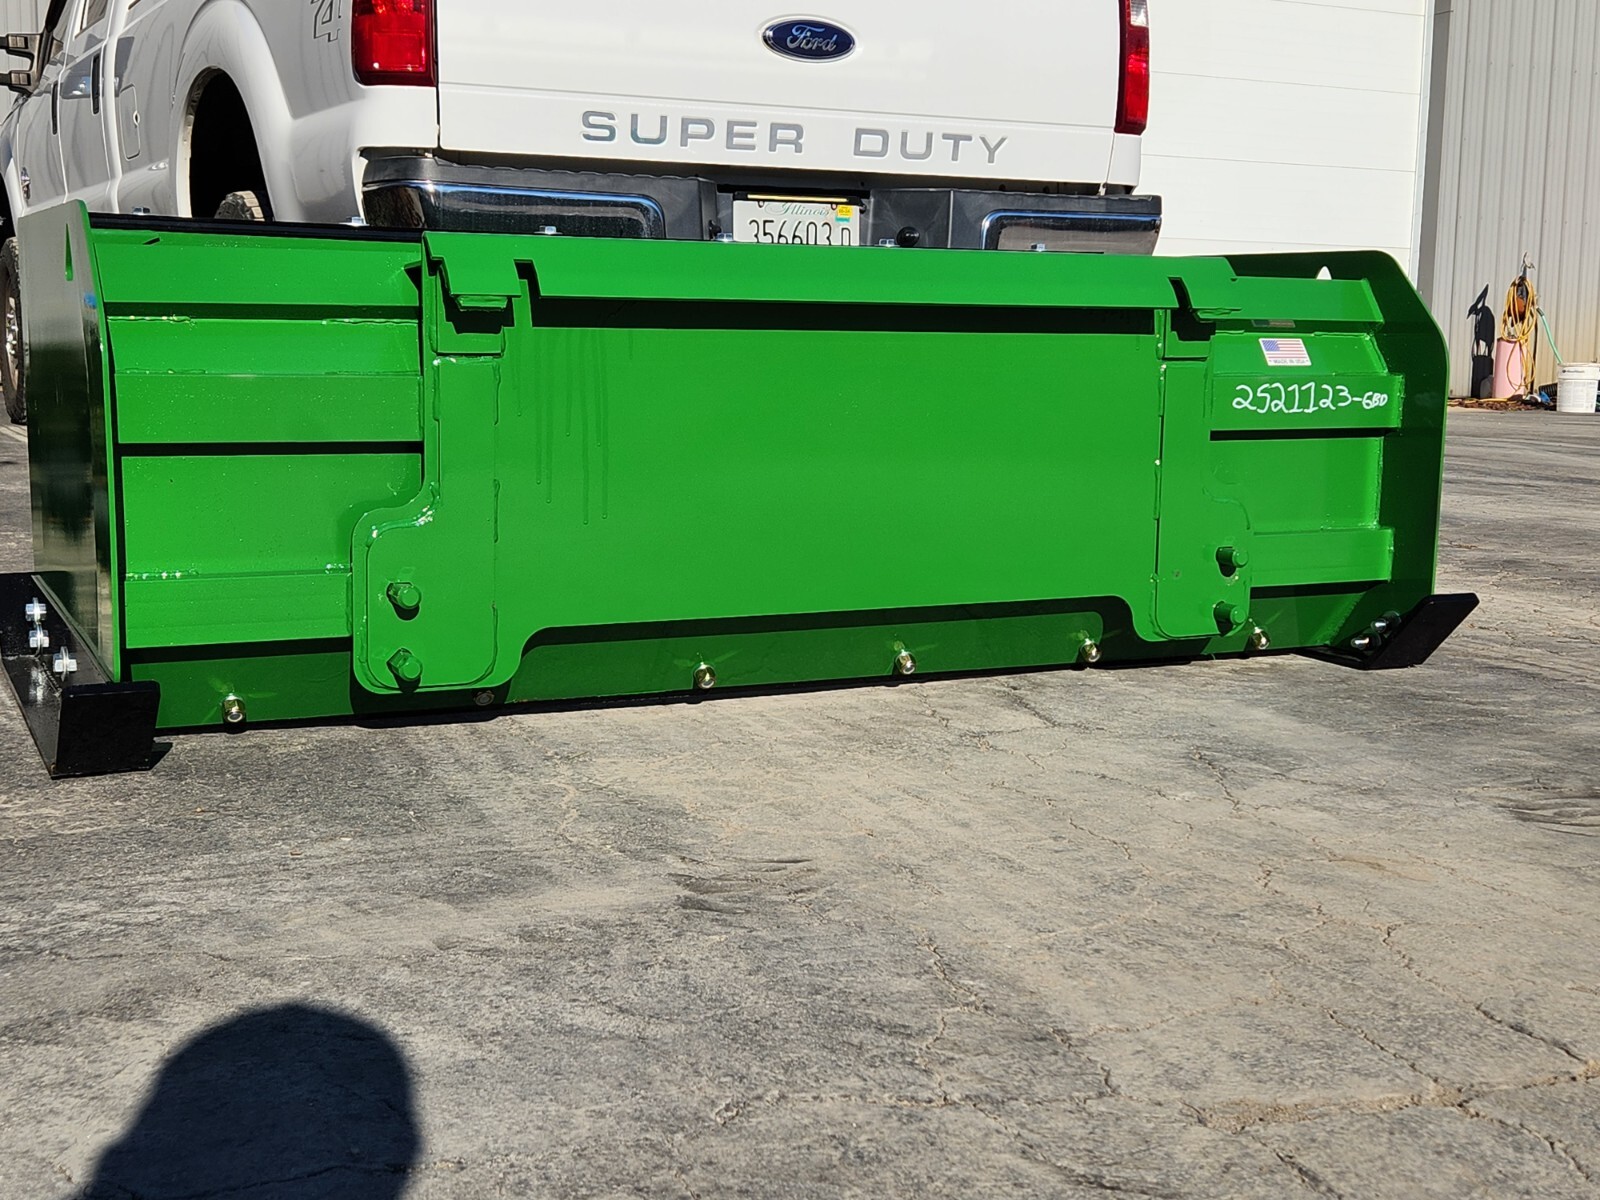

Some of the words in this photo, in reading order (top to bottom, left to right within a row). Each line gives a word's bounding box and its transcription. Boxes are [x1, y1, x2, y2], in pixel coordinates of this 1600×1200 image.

[786, 24, 837, 52] Ford
[581, 110, 804, 154] SUPER
[853, 128, 1008, 164] DUTY
[765, 201, 830, 216] Illinois
